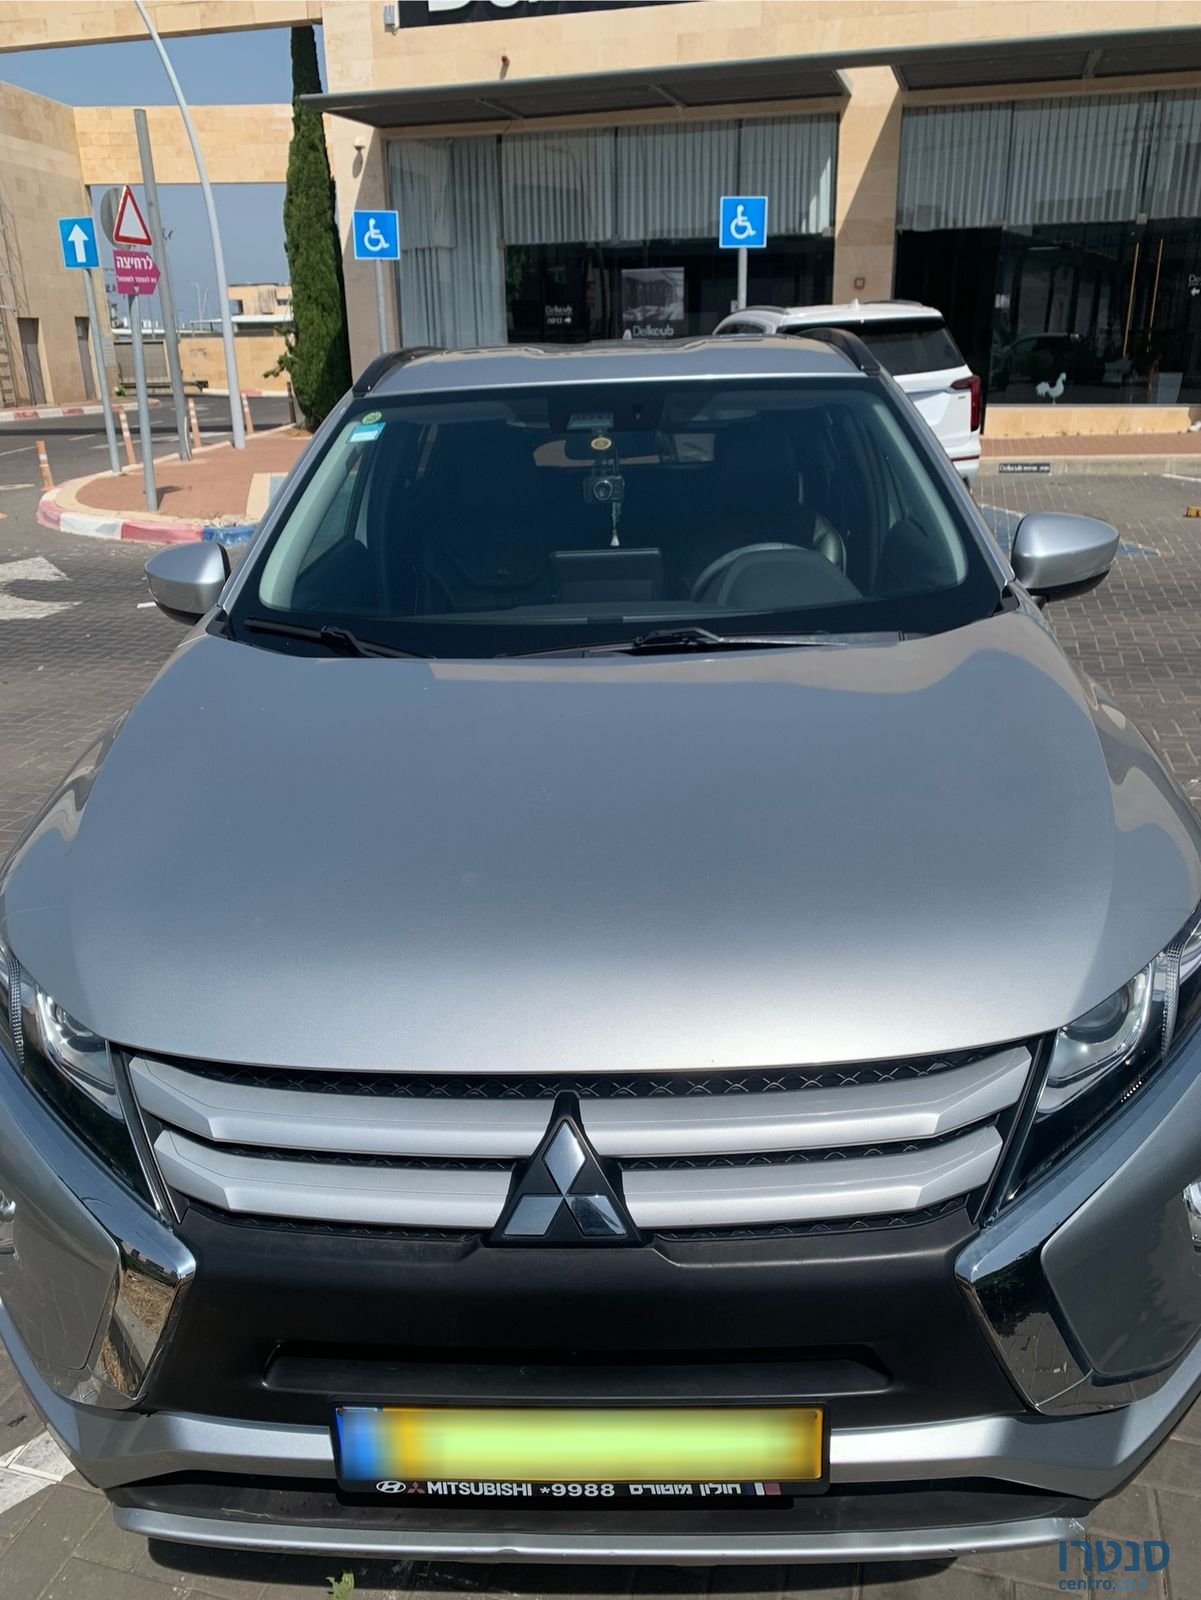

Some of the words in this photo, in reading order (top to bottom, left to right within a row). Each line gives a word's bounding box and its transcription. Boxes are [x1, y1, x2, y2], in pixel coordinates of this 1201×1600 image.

[116, 255, 153, 270] לרחיצה
[427, 1481, 532, 1497] MITSUBISHI
[629, 1483, 693, 1496] מוטורס
[700, 1483, 742, 1496] חולון
